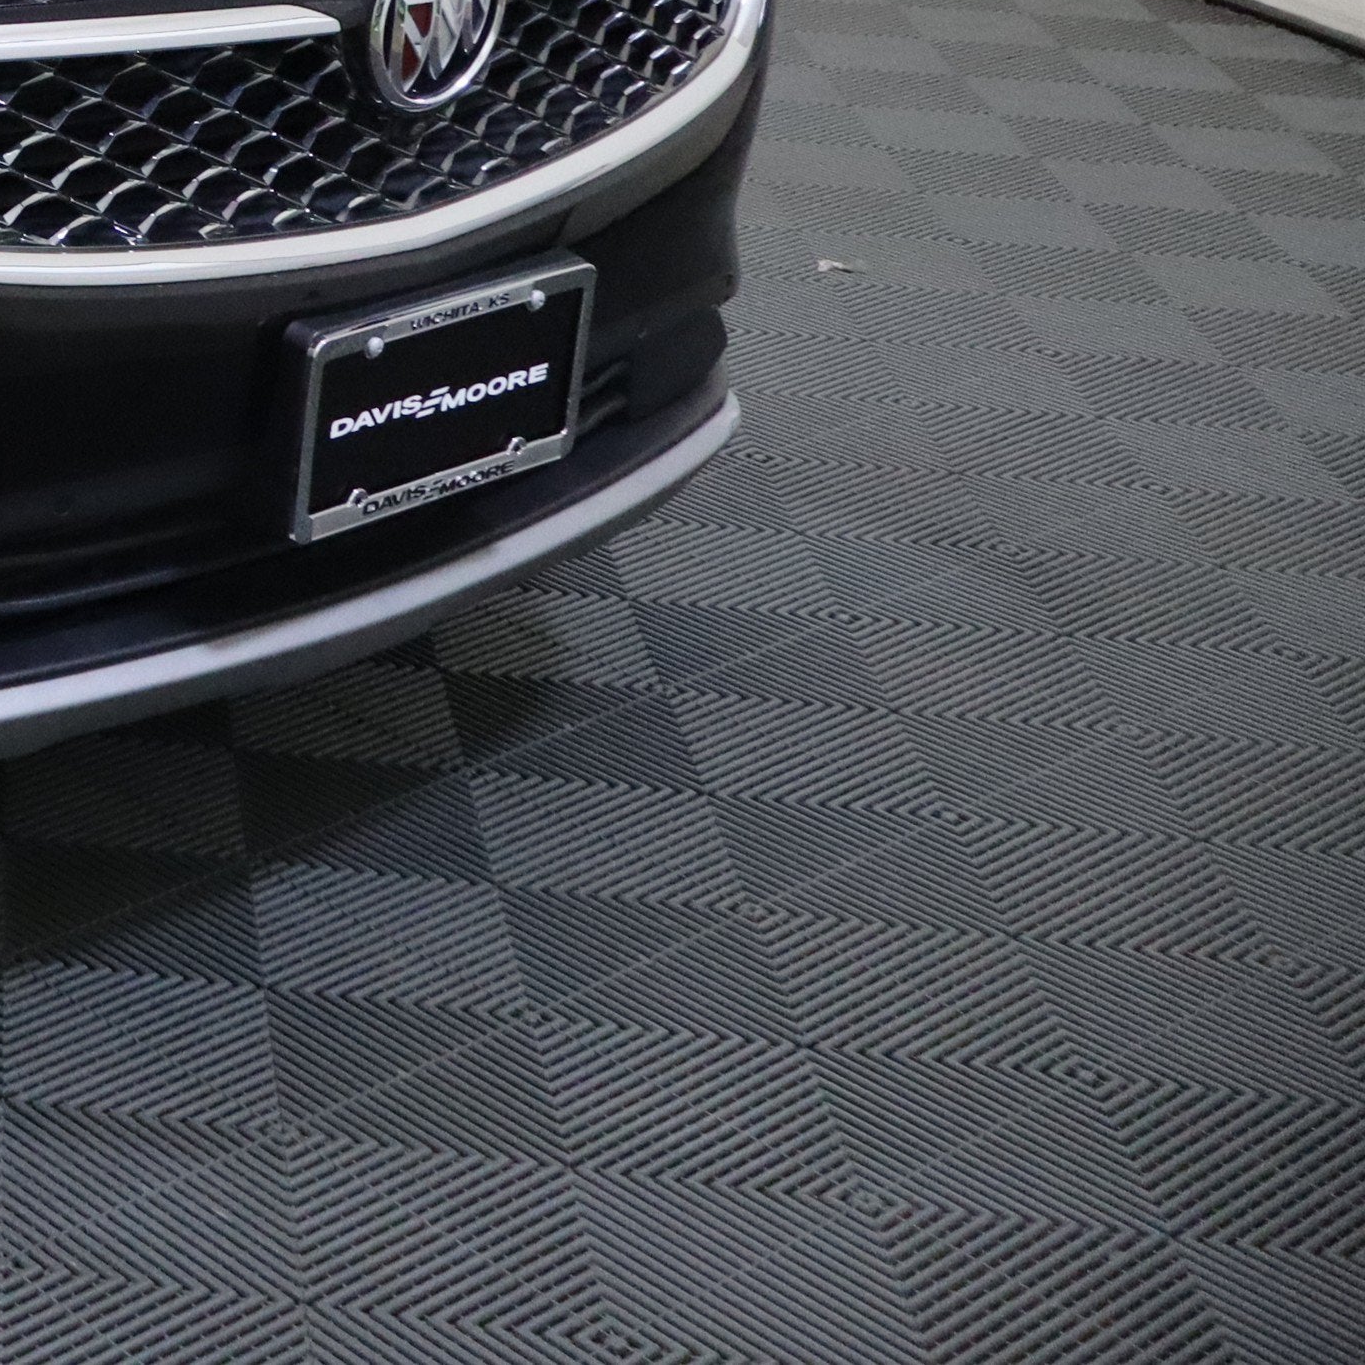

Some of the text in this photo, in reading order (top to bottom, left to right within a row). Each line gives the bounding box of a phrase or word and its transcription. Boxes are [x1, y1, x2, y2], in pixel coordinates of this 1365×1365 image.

[488, 293, 510, 309] KS
[329, 362, 549, 439] DAVIS MOORE
[362, 460, 515, 517] DAVIS MOORE
